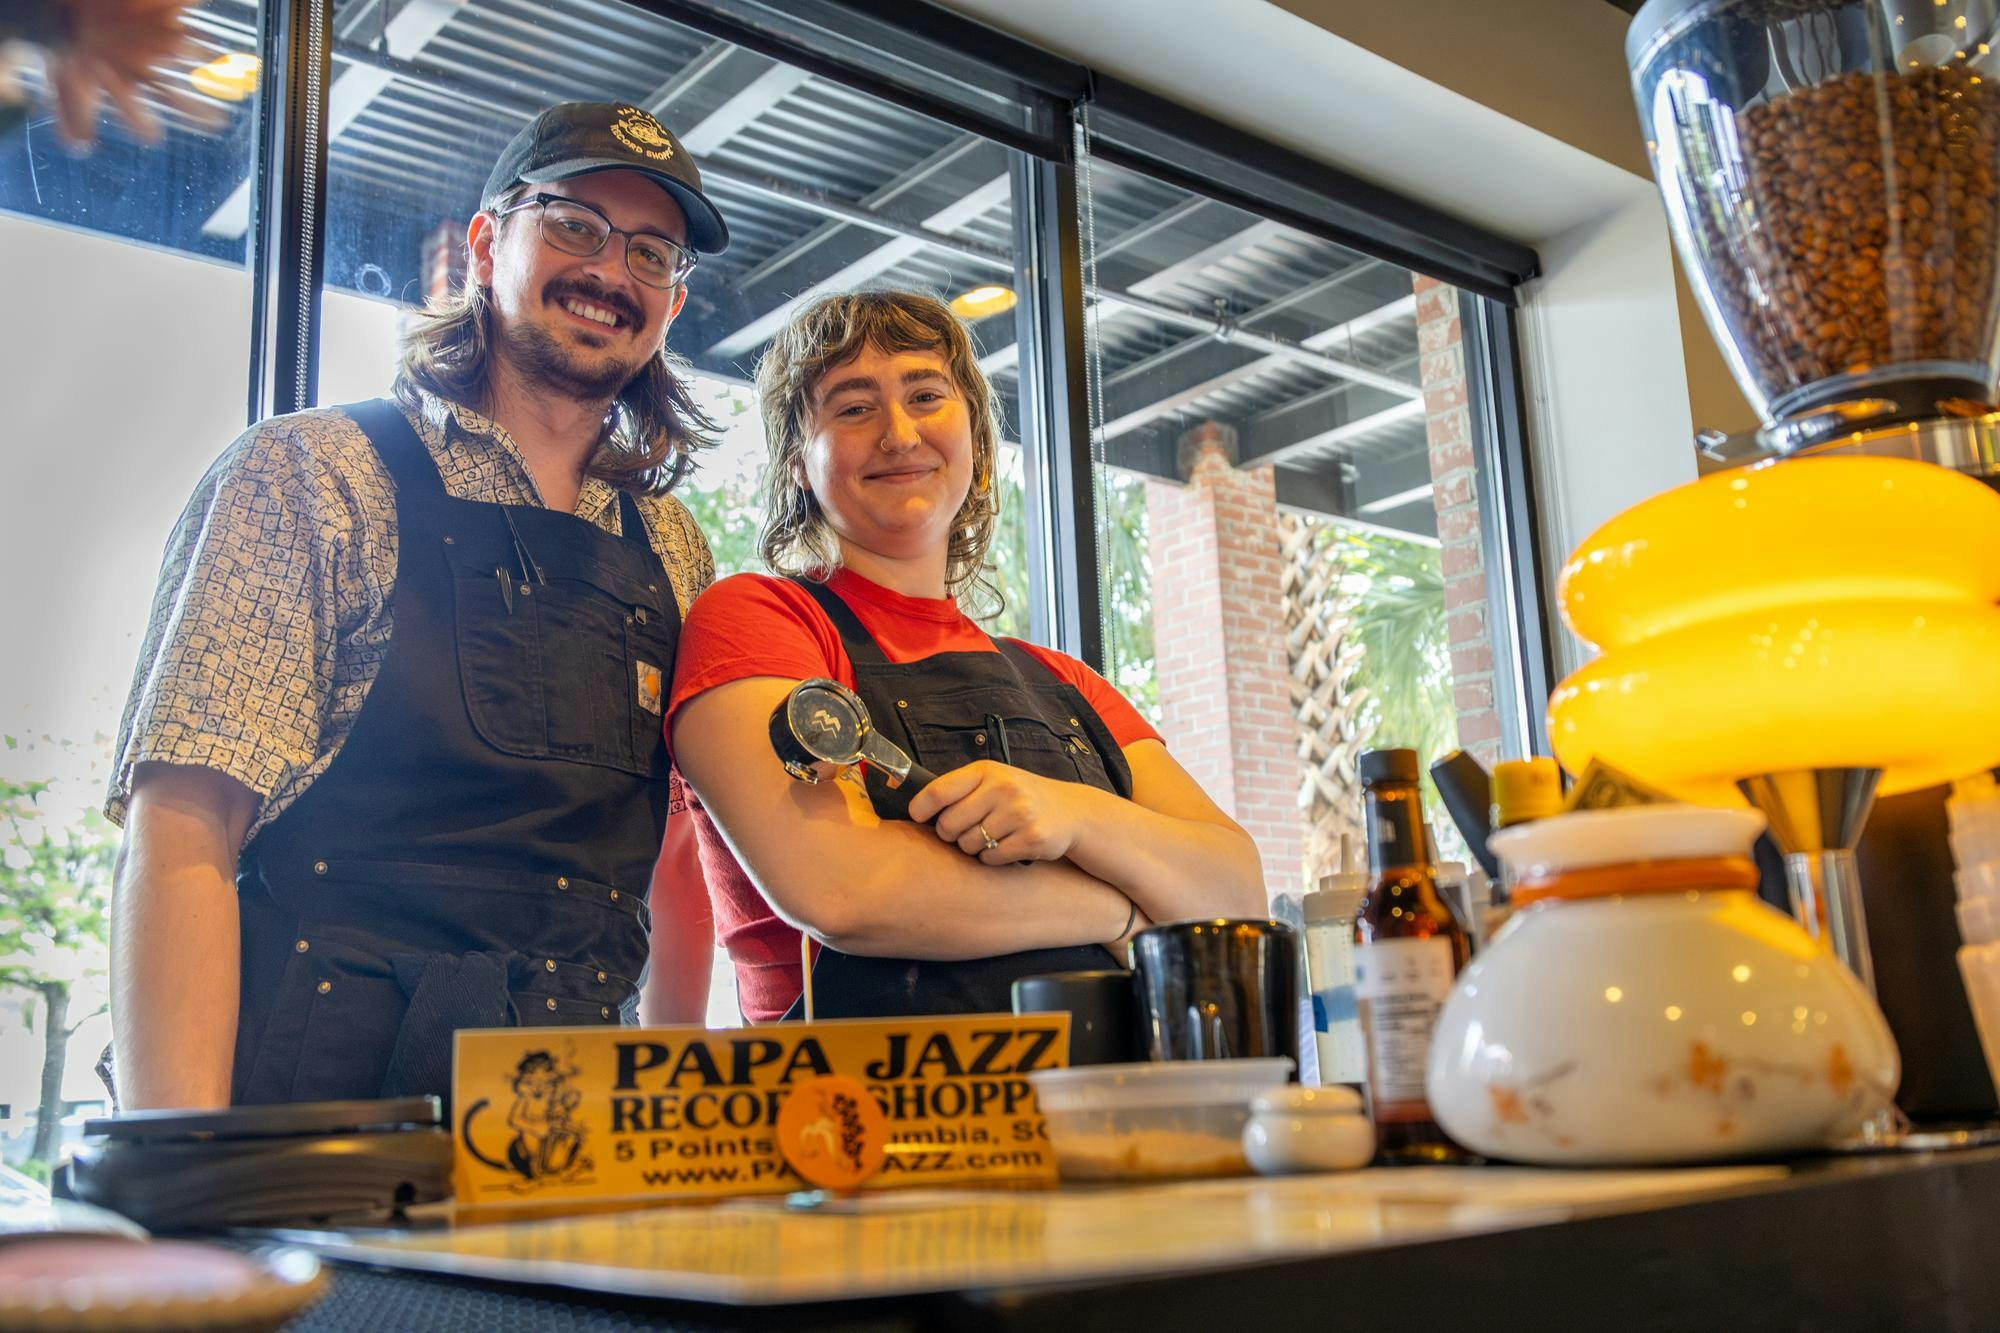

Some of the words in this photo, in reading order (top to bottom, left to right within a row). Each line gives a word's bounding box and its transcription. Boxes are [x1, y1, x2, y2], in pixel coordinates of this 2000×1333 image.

[610, 125, 643, 153] RECORD
[613, 1035, 832, 1090] PAPA
[865, 1030, 1059, 1080] JAZZ
[610, 1090, 791, 1133] RECO
[866, 1080, 1044, 1121] SHOPP
[614, 1138, 635, 1162] 5
[651, 1136, 774, 1160] Points
